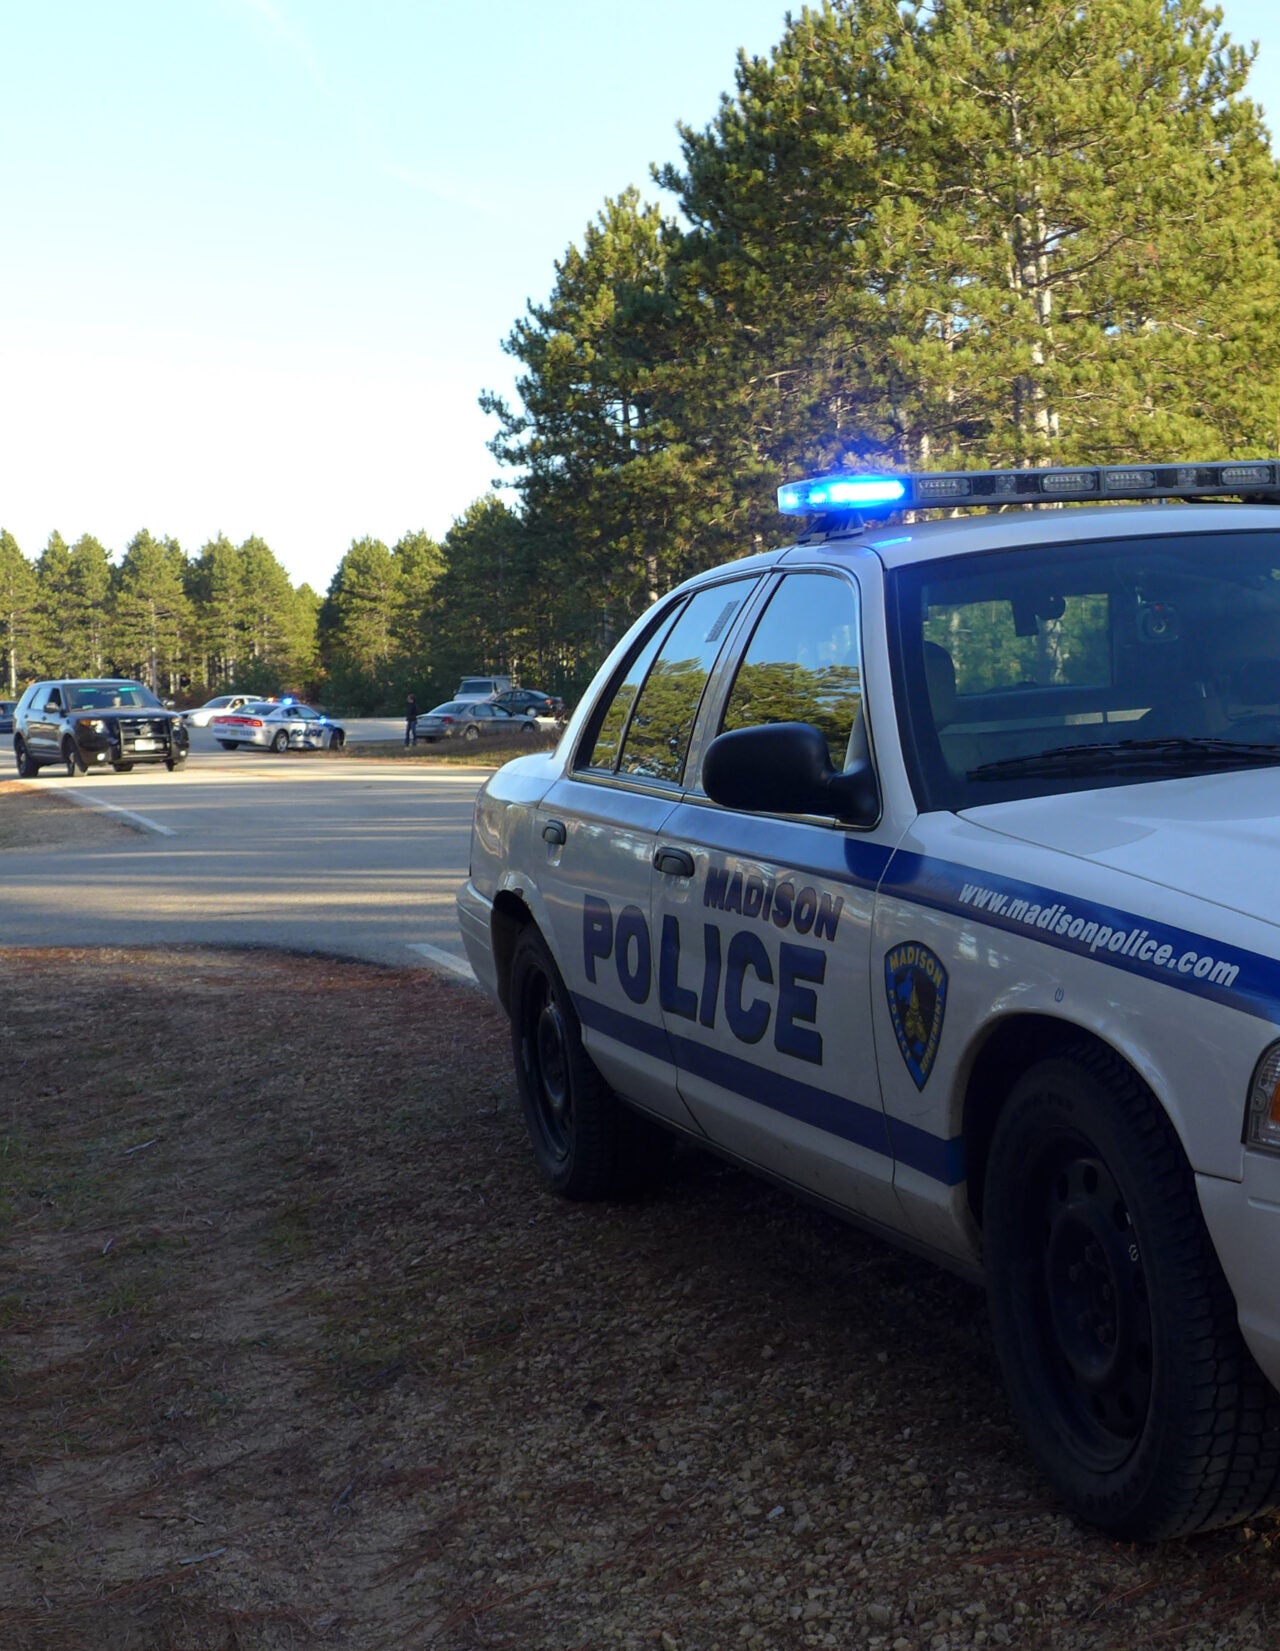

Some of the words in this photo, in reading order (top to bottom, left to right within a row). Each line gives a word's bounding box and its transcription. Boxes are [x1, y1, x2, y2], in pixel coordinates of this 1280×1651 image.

[703, 867, 844, 941] MADISON
[958, 884, 1240, 987] www.madisonpolice.com
[583, 893, 827, 1066] POLICE
[890, 947, 943, 988] MADISON
